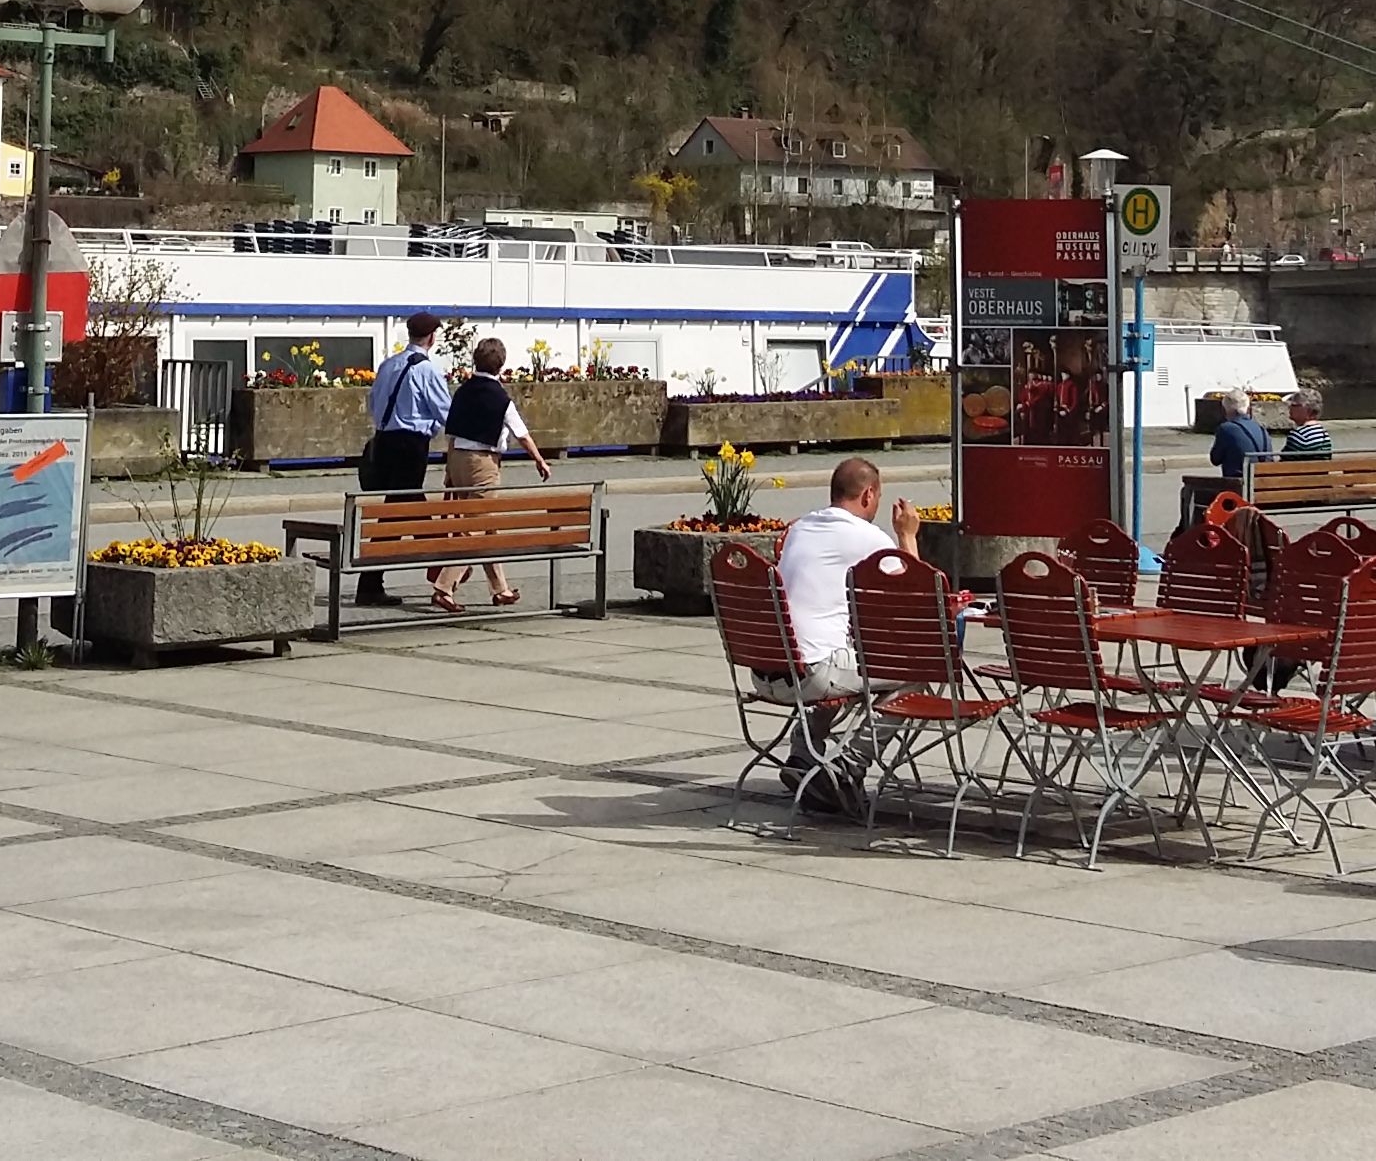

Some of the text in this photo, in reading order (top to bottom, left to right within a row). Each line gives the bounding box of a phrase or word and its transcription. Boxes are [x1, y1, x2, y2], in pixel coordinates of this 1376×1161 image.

[1133, 198, 1149, 225] H
[1055, 231, 1100, 240] OBERHAUS
[1056, 242, 1100, 251] MUSEUM
[1122, 241, 1157, 254] CITY
[1056, 251, 1100, 261] PASSAU
[968, 288, 996, 299] VESTE
[968, 300, 1043, 315] OBERHAUS
[1058, 455, 1103, 465] PASSAU
